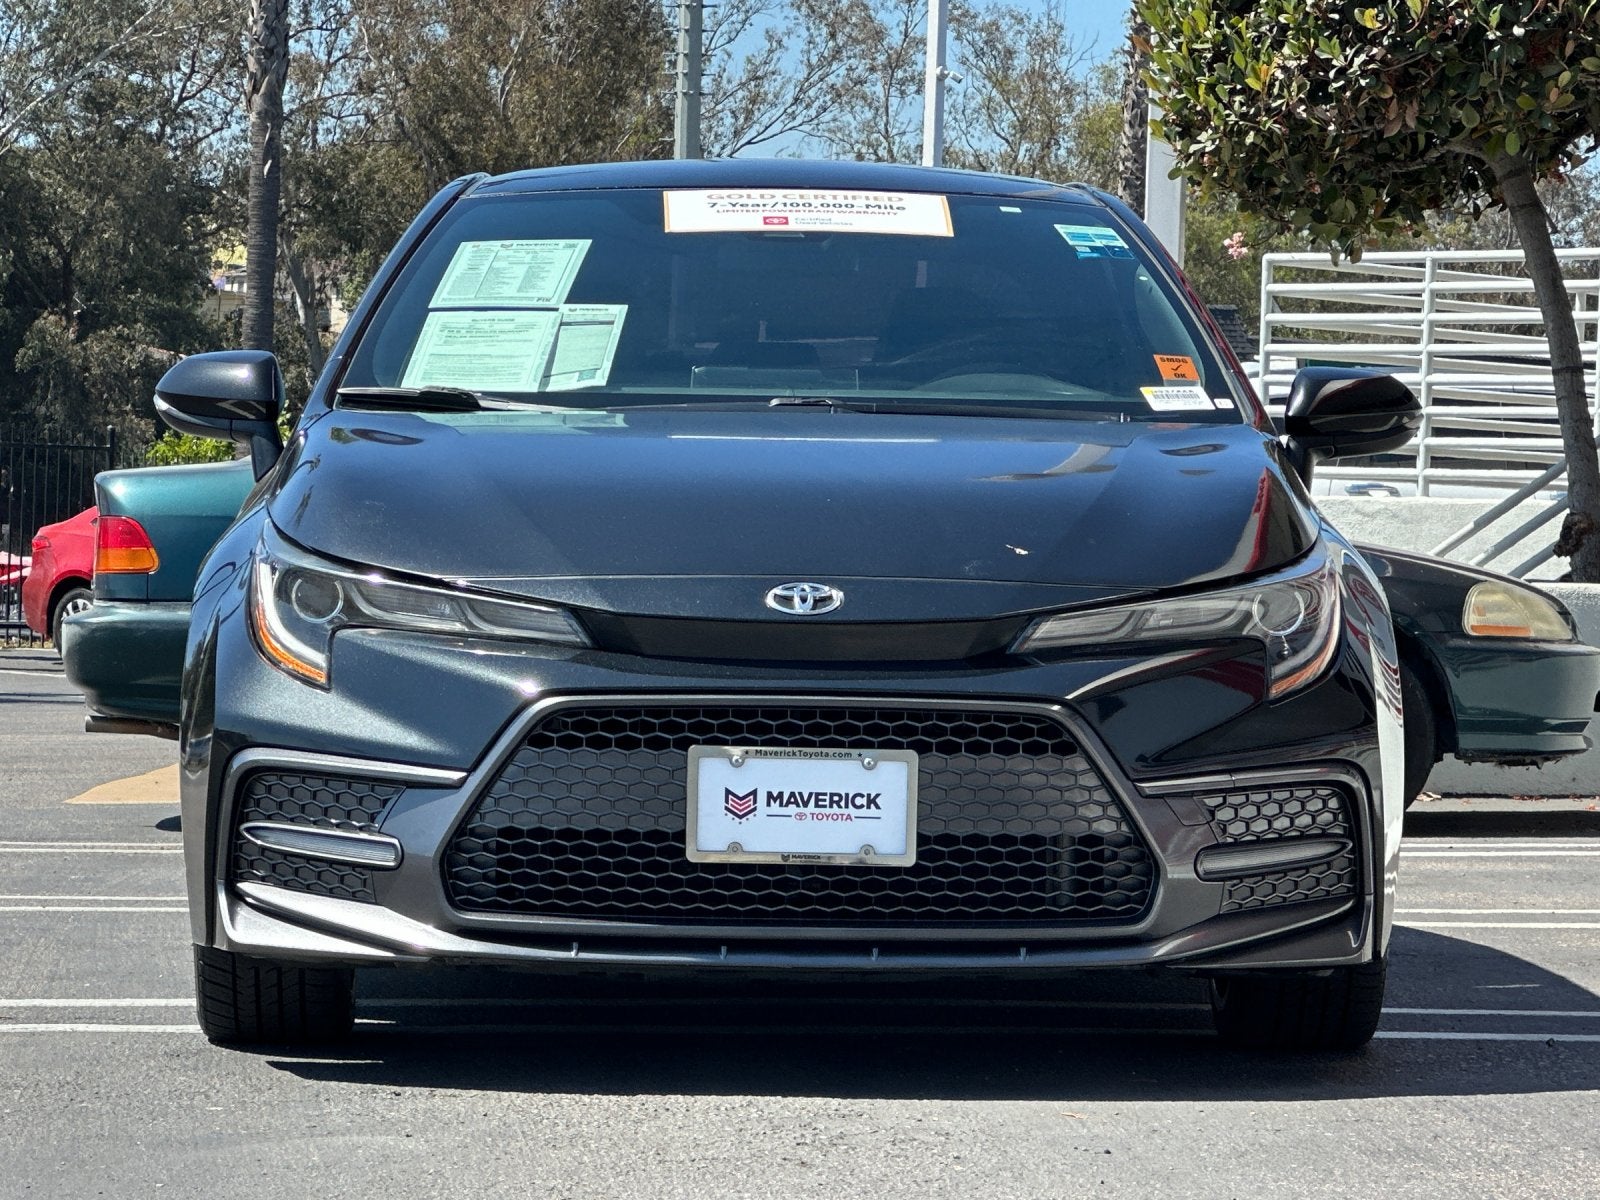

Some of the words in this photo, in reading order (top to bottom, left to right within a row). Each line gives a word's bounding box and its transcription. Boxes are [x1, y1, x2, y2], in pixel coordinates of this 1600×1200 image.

[781, 193, 905, 203] CERTIFIED
[707, 201, 906, 212] 7-Year/100,000-Mile
[755, 749, 853, 759] MaverickToyota.com
[766, 790, 882, 810] MAVERICK
[810, 812, 853, 822] TOYOTA
